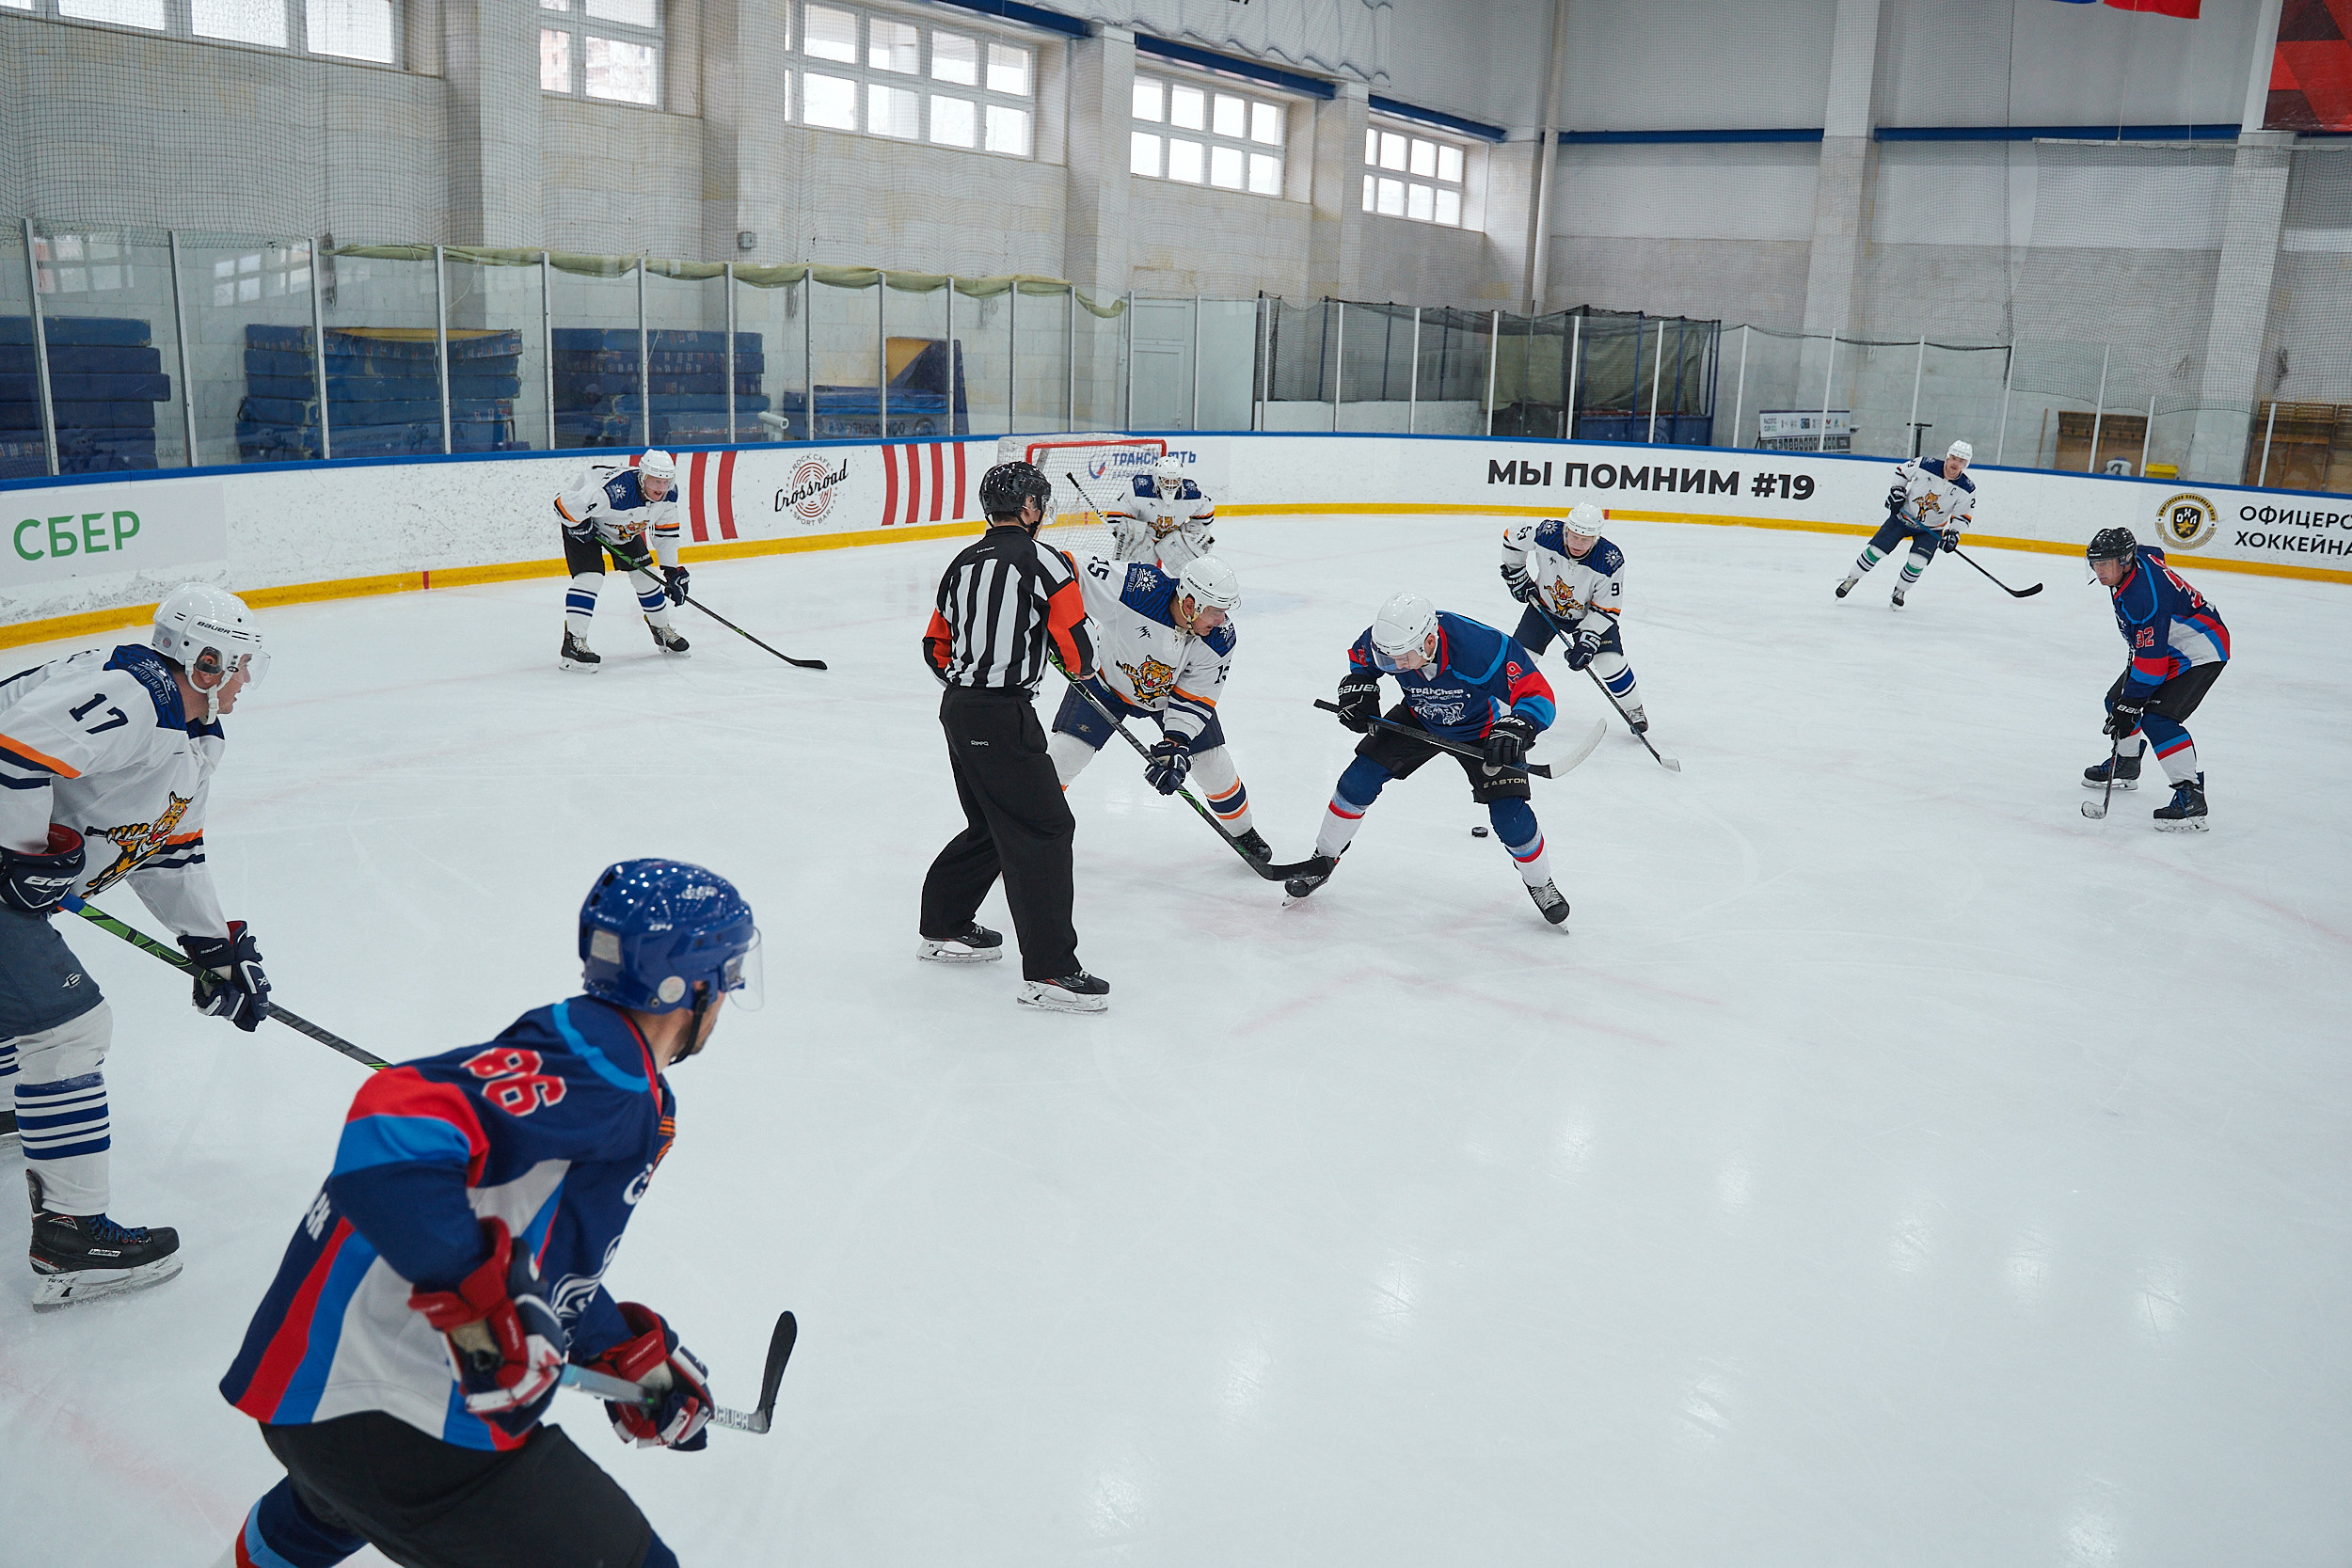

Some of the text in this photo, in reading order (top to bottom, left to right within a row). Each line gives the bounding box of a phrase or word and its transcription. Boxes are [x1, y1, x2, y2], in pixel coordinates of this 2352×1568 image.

[792, 454, 832, 470] ROCK CAFE
[1487, 459, 1815, 500] МЫ ПОМНИМ #19
[775, 458, 849, 512] Crossroad
[13, 510, 140, 561] СБЕР
[792, 509, 832, 527] SPORT BAR
[1116, 532, 1126, 562] VAUGHN
[197, 621, 231, 635] BAUER
[2136, 627, 2154, 648] 32
[128, 663, 169, 705] UNITED FAR EAST
[69, 692, 129, 735] 17
[1483, 777, 1527, 789] EASTON
[459, 1047, 567, 1117] 86
